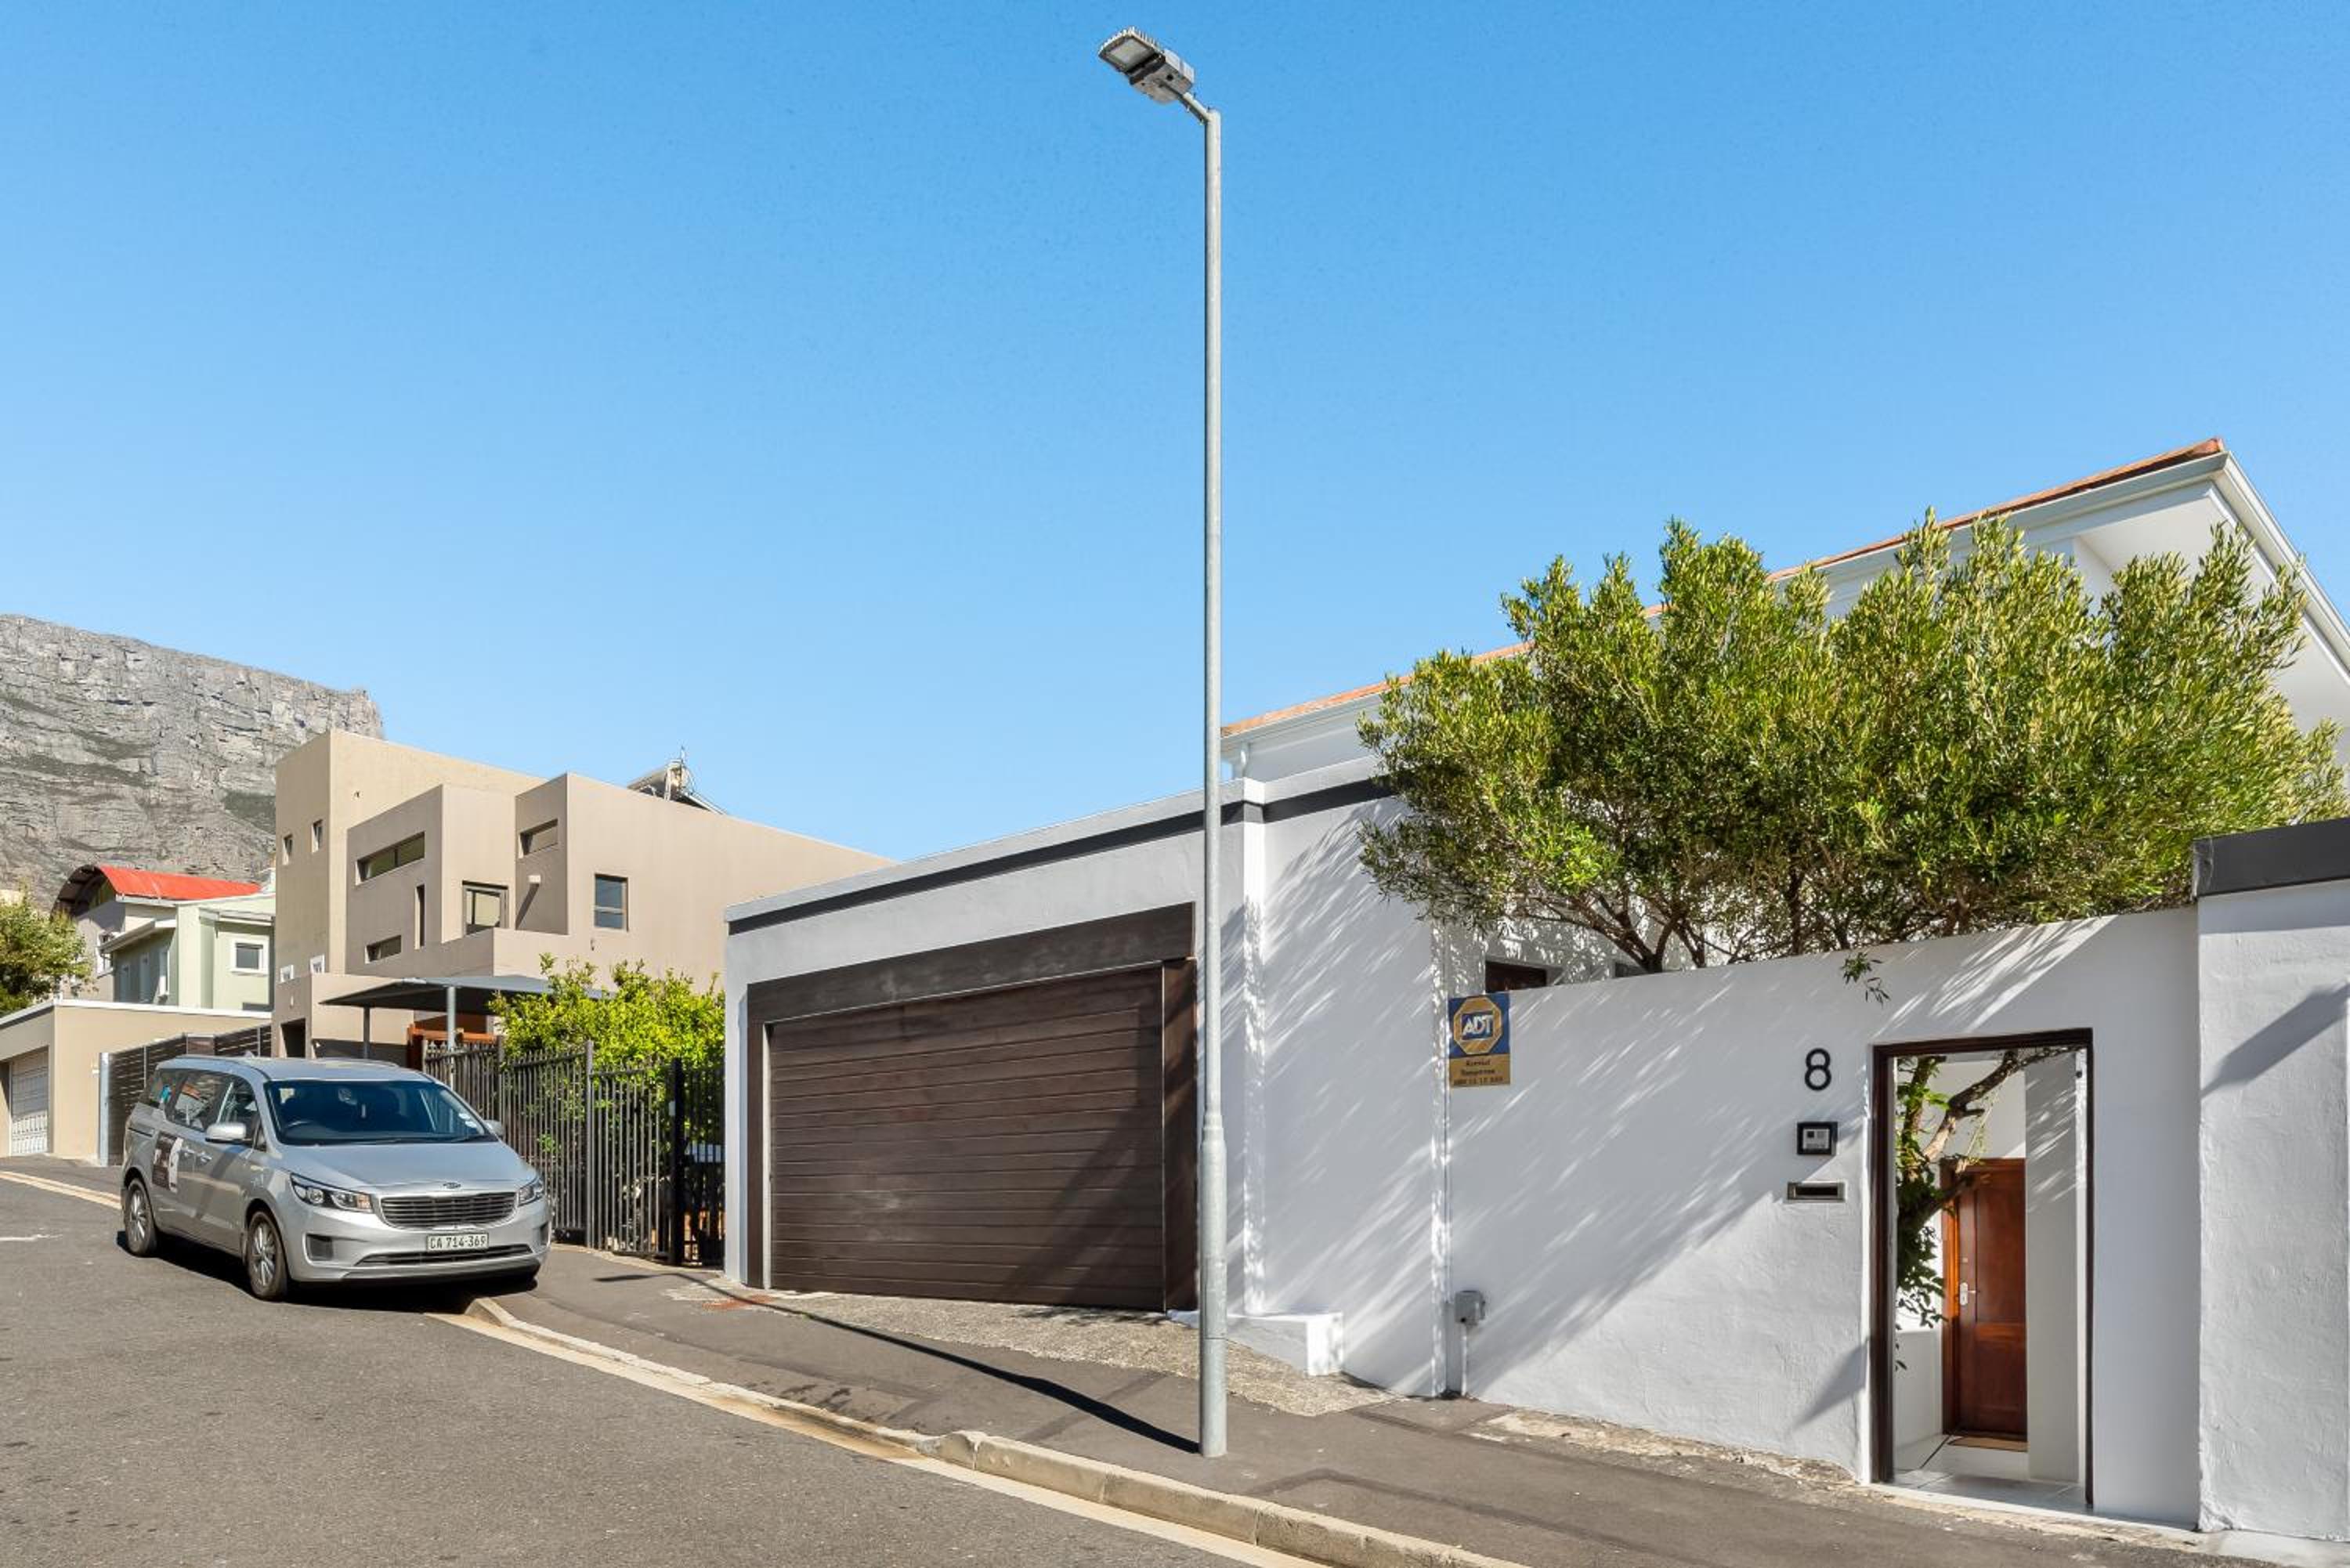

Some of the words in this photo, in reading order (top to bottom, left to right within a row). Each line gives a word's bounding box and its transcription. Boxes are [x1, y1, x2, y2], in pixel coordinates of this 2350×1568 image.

[1462, 1014, 1493, 1035] ADT
[1804, 1048, 1831, 1091] 8
[430, 1237, 443, 1249] CA
